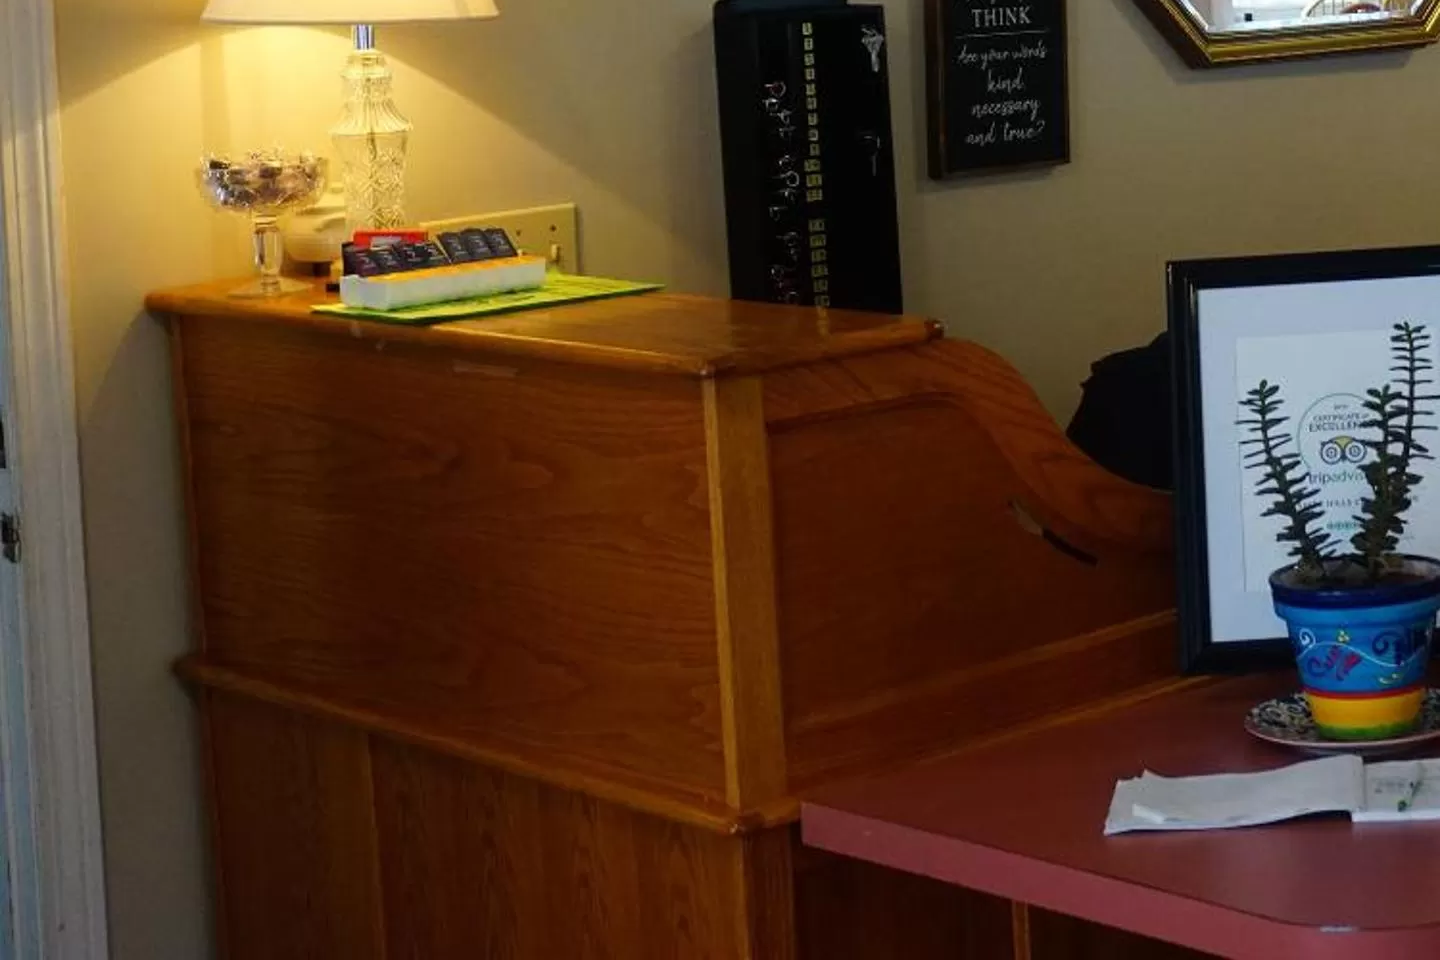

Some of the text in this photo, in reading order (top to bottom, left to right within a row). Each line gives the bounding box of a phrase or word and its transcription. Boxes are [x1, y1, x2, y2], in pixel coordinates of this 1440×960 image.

[971, 5, 1032, 28] THINK
[971, 99, 1040, 121] necessary
[964, 121, 996, 147] and
